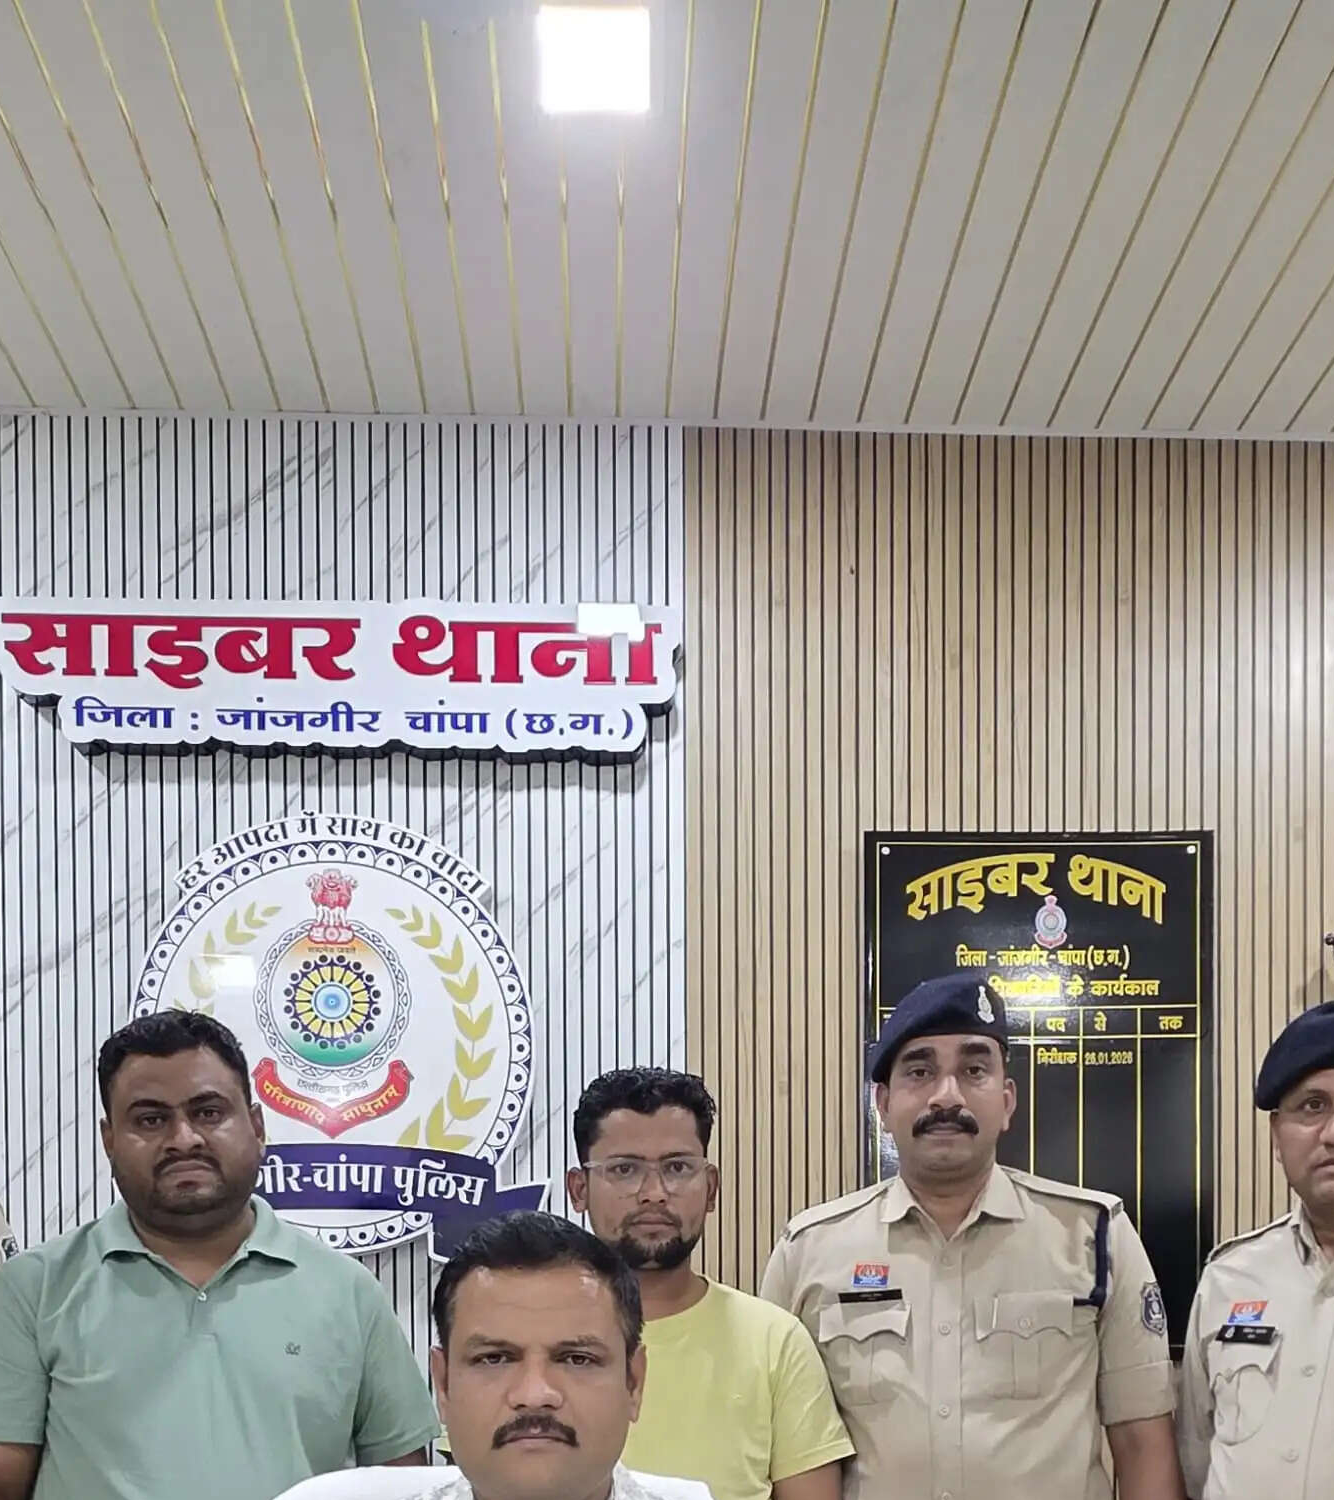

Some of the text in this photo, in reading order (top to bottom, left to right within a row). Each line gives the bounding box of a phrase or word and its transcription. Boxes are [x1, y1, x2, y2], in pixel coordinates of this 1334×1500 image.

[1, 613, 661, 688] साइबर थाना
[74, 697, 175, 732] जिला
[215, 696, 380, 735] जांजगीर
[404, 699, 489, 735] चांपा
[504, 705, 635, 740] (छ.ग.)
[179, 810, 485, 896] हर आपदा में साथ का वादा
[906, 853, 1166, 924] साइबर थाना
[1066, 974, 1161, 997] के कार्यकाल
[1046, 1011, 1185, 1032] पद से तक
[394, 1158, 488, 1206] पुलिस
